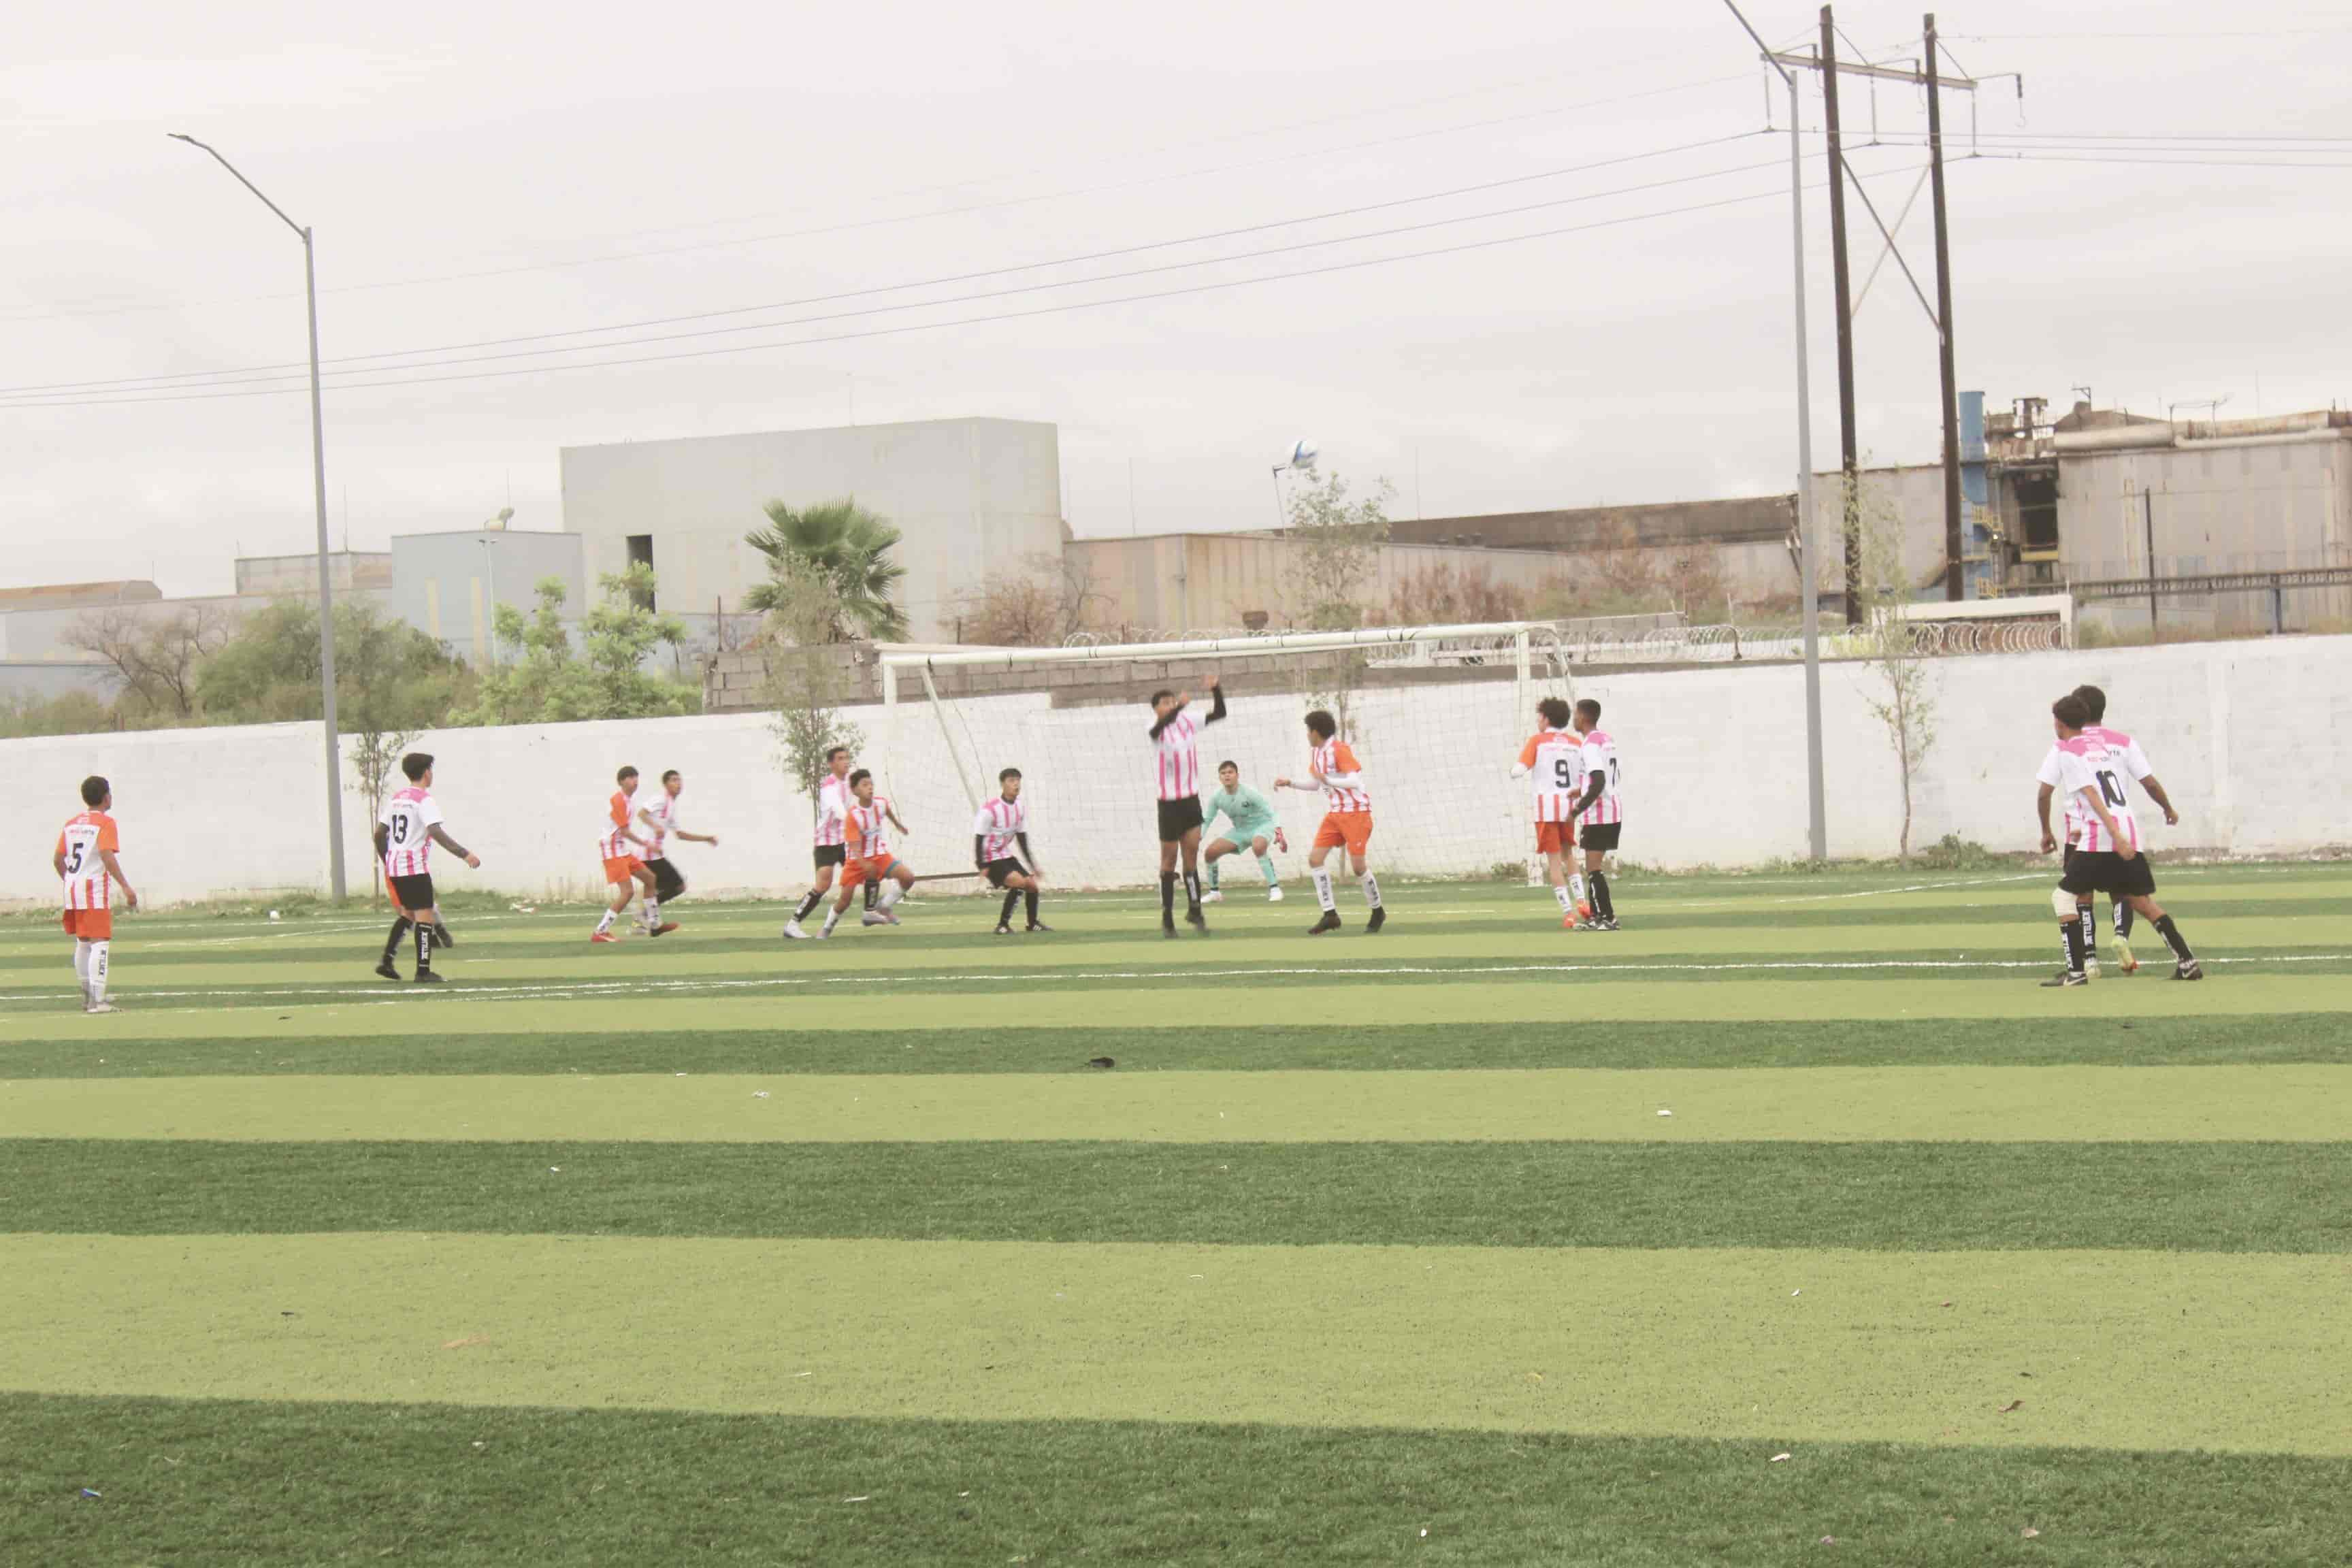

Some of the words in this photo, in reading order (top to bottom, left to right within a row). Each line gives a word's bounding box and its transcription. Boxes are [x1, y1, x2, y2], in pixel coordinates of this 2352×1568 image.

[1555, 759, 1571, 788] 9
[2096, 770, 2126, 808] 10
[392, 814, 408, 844] 13
[68, 843, 84, 874] 5
